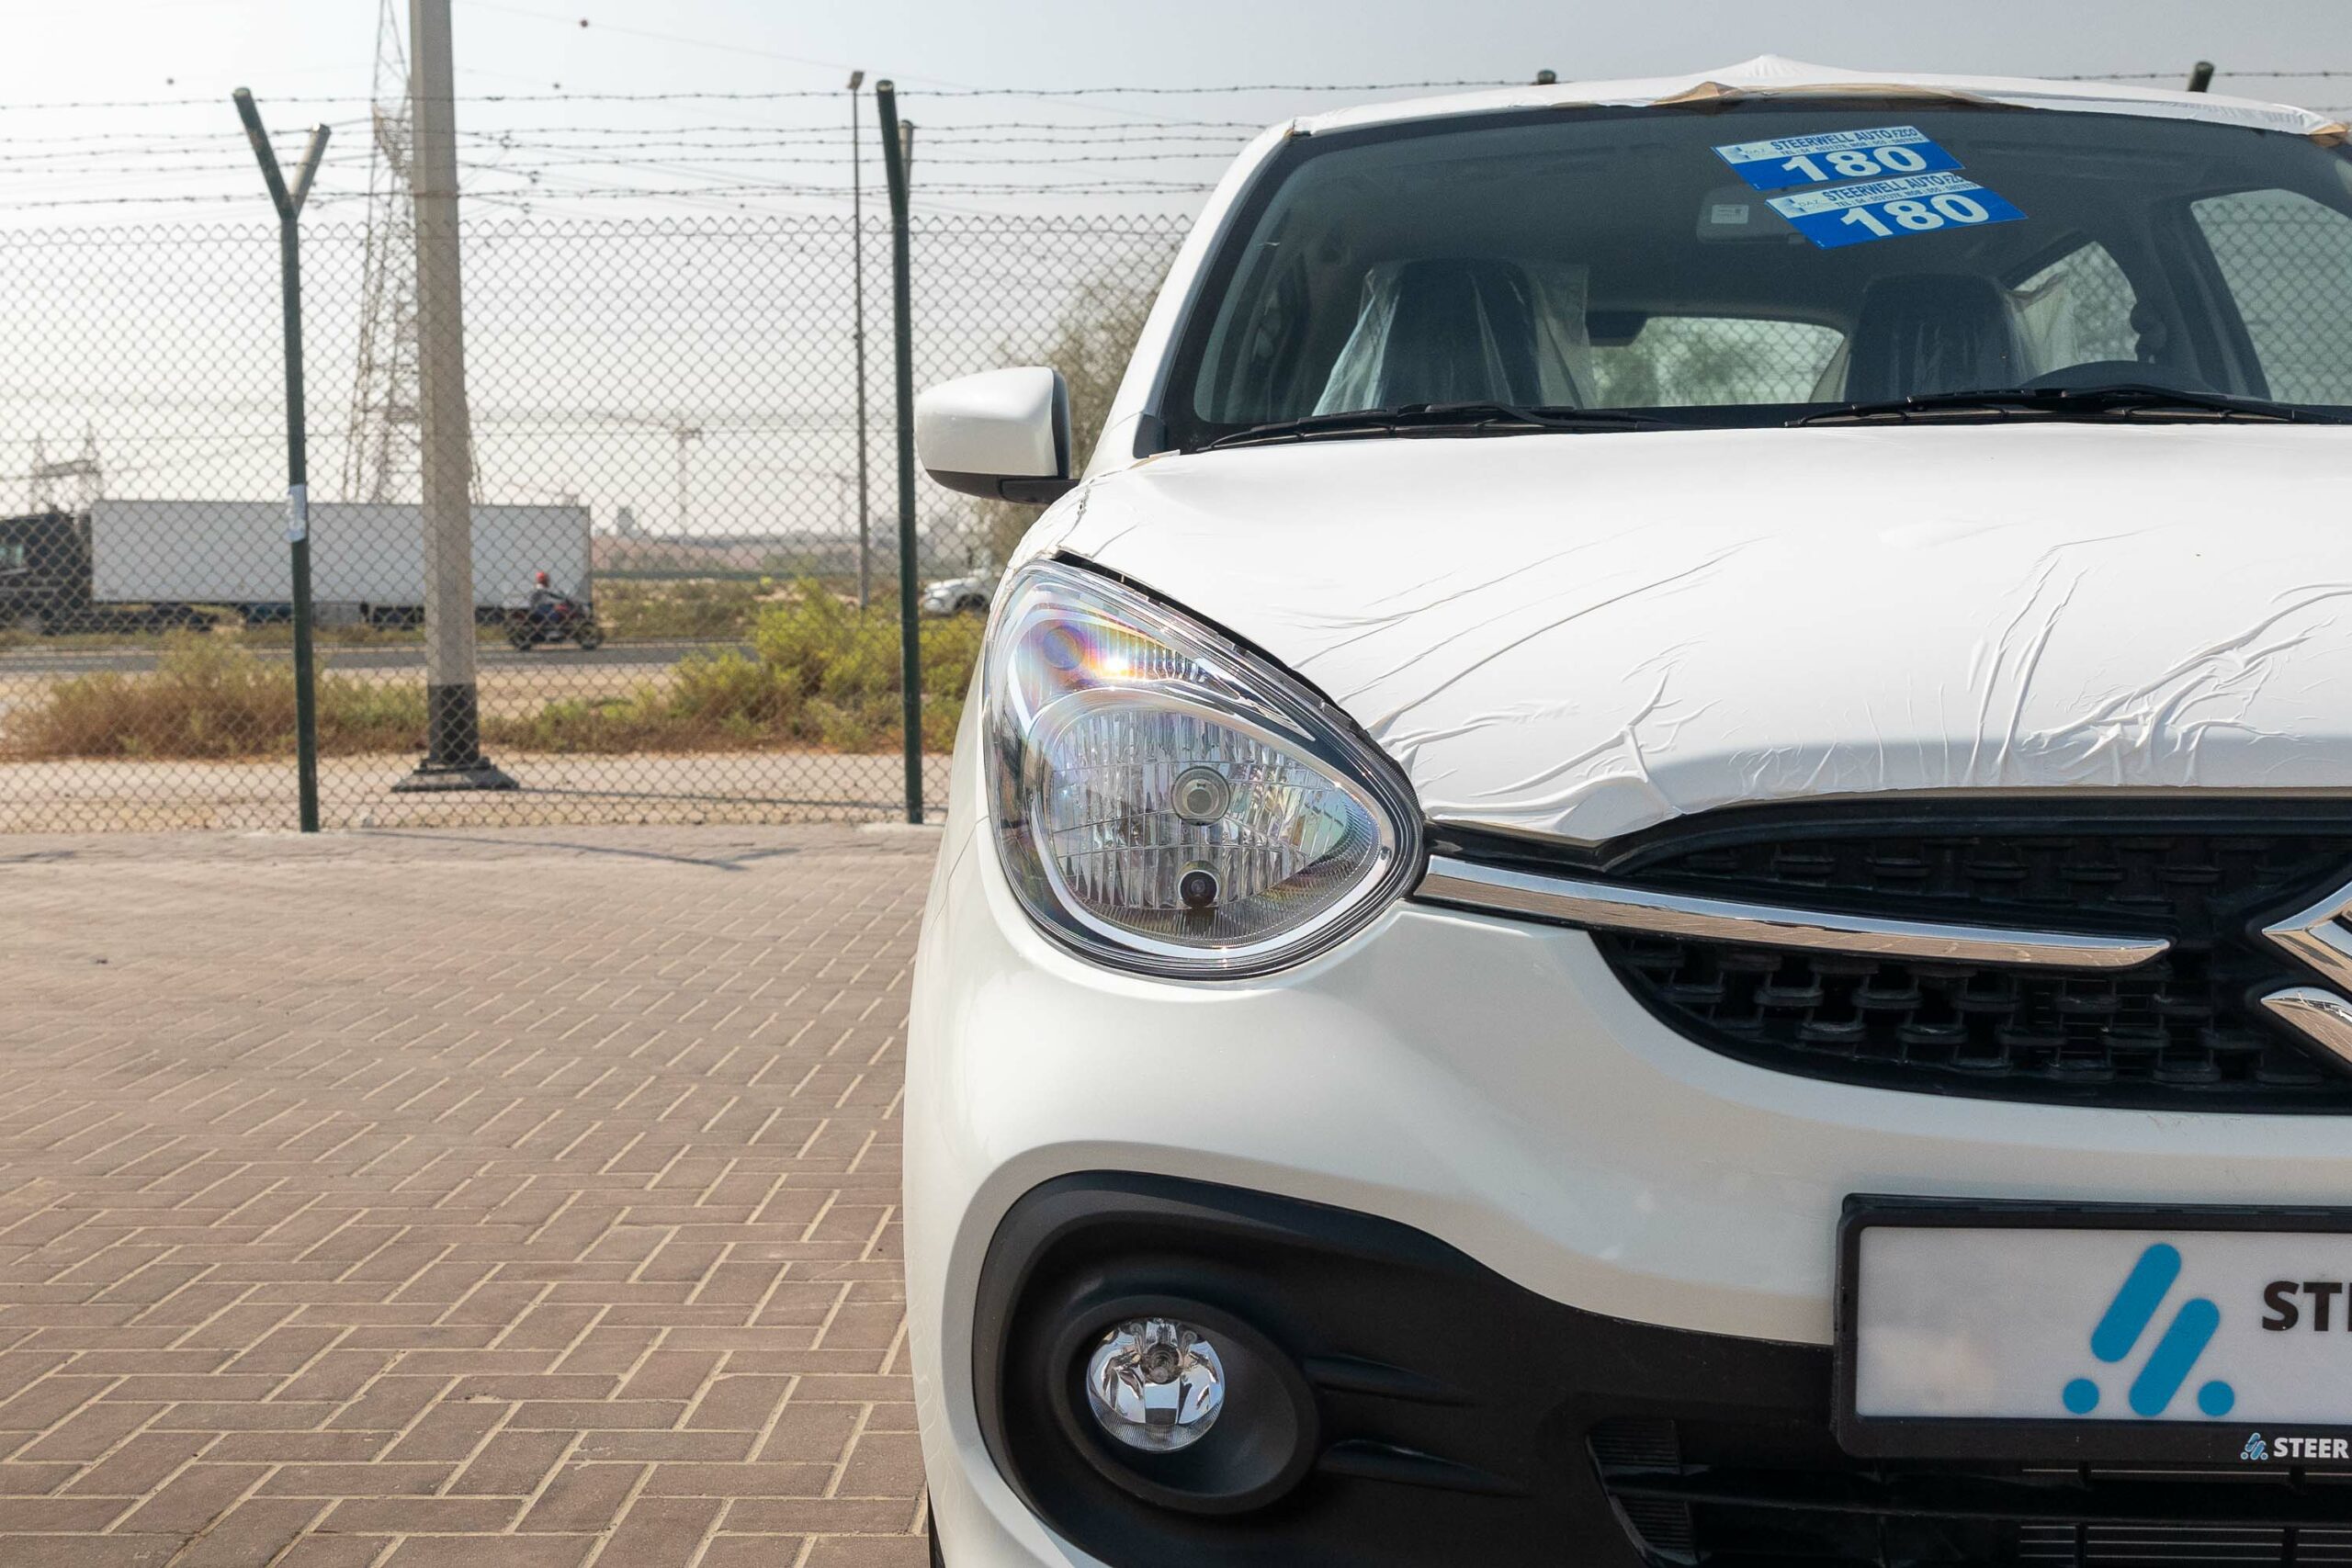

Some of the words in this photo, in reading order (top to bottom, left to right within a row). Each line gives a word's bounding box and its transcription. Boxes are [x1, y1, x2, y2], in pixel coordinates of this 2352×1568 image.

[1770, 132, 1854, 150] STEERWELL
[1854, 130, 1892, 141] AUTO
[1891, 128, 1918, 138] FZCO
[1781, 146, 1927, 182] 180
[1822, 180, 1906, 201] STEERWELL
[1905, 175, 1944, 189] AUTO
[1945, 174, 1963, 184] FZC
[1840, 193, 1989, 236] 180
[2262, 1280, 2352, 1332] ST
[2273, 1437, 2349, 1459] STEER
